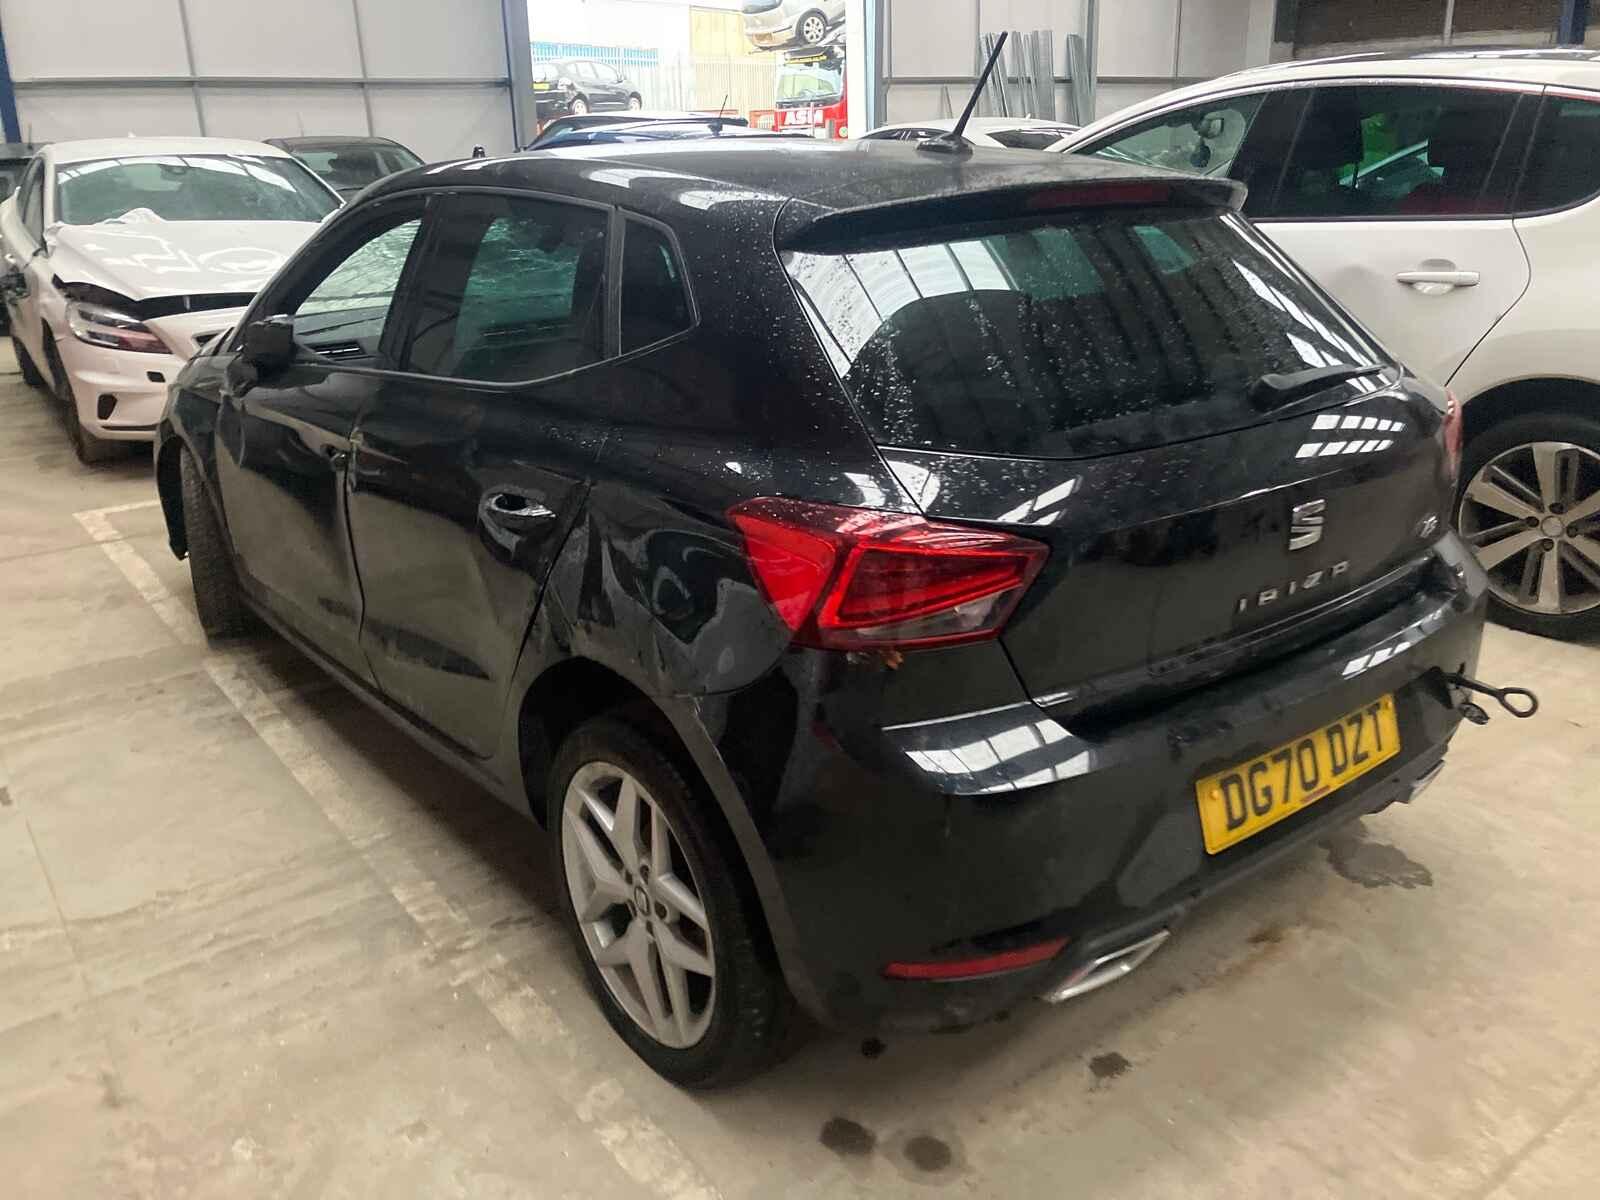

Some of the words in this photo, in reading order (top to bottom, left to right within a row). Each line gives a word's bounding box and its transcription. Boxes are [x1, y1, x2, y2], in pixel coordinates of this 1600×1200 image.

[1238, 560, 1349, 612] IBIZA
[1220, 738, 1319, 831] DG70
[1326, 702, 1382, 776] DZT
